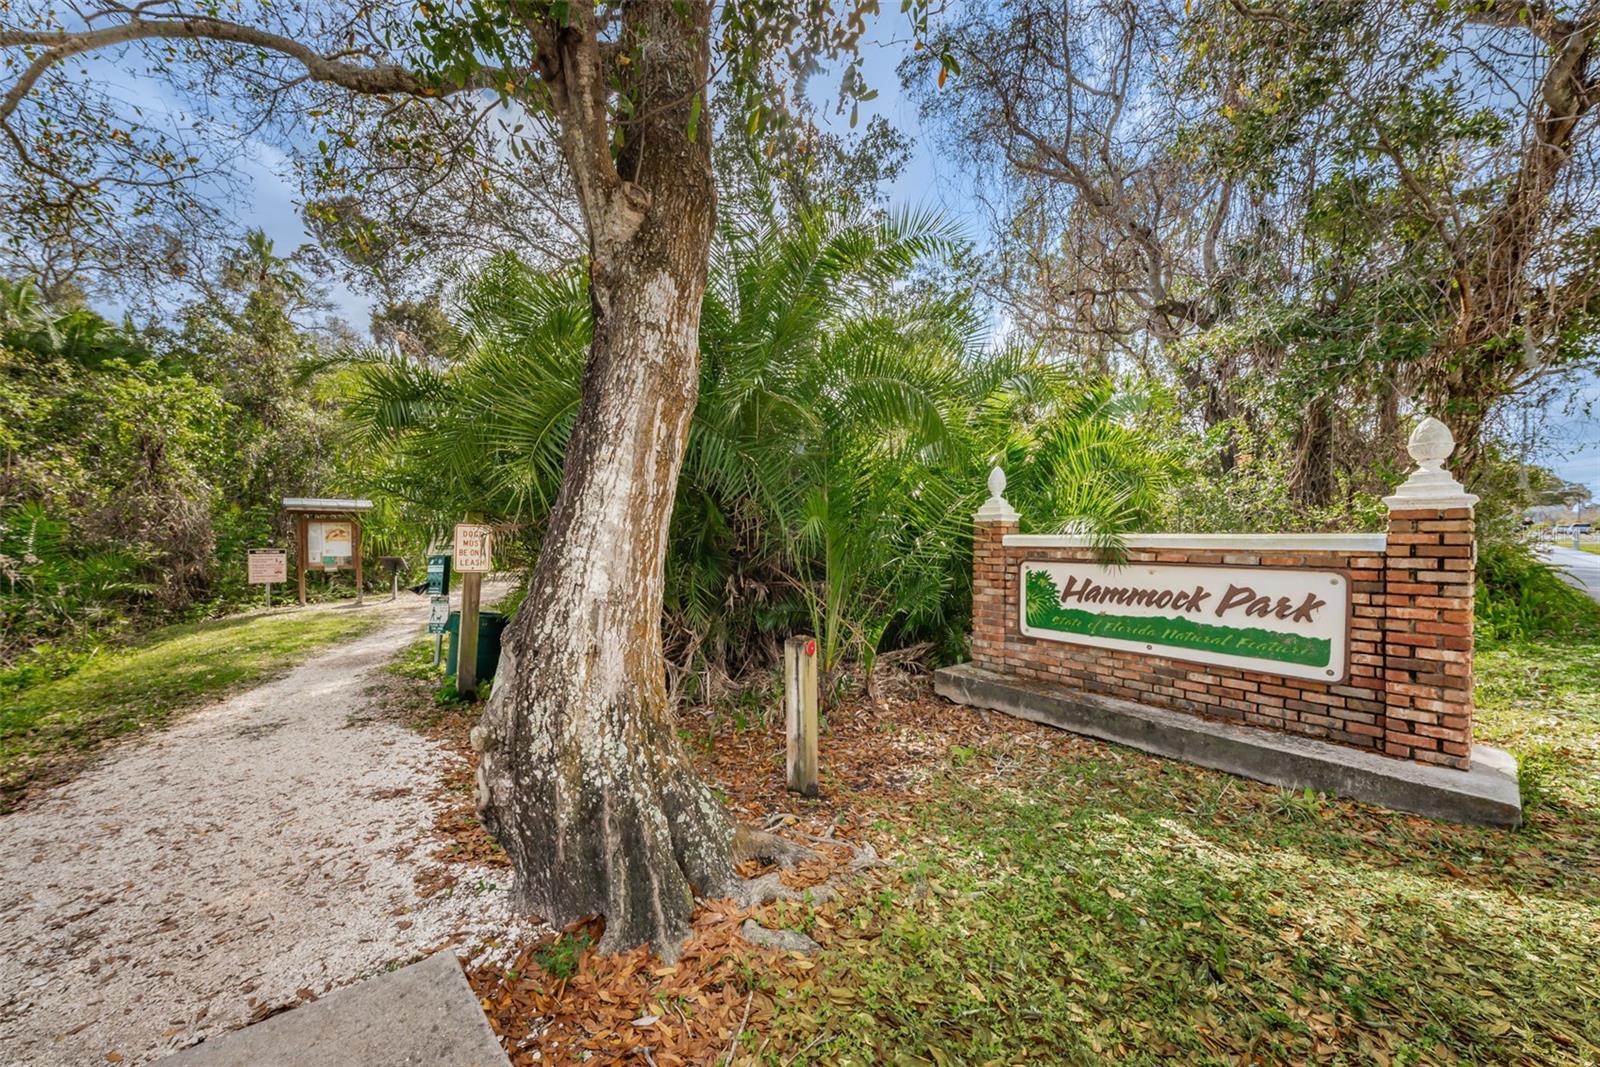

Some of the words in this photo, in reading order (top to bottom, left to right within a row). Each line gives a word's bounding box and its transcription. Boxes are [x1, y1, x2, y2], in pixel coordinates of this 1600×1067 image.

[459, 549, 467, 557] BE
[470, 549, 480, 557] ON
[460, 559, 485, 567] LEASH
[1061, 575, 1212, 613] Hammock
[1215, 583, 1327, 623] Park
[1051, 615, 1083, 628] State
[1087, 618, 1102, 635] of
[1104, 621, 1157, 638] Florida
[1160, 628, 1233, 647] Natural
